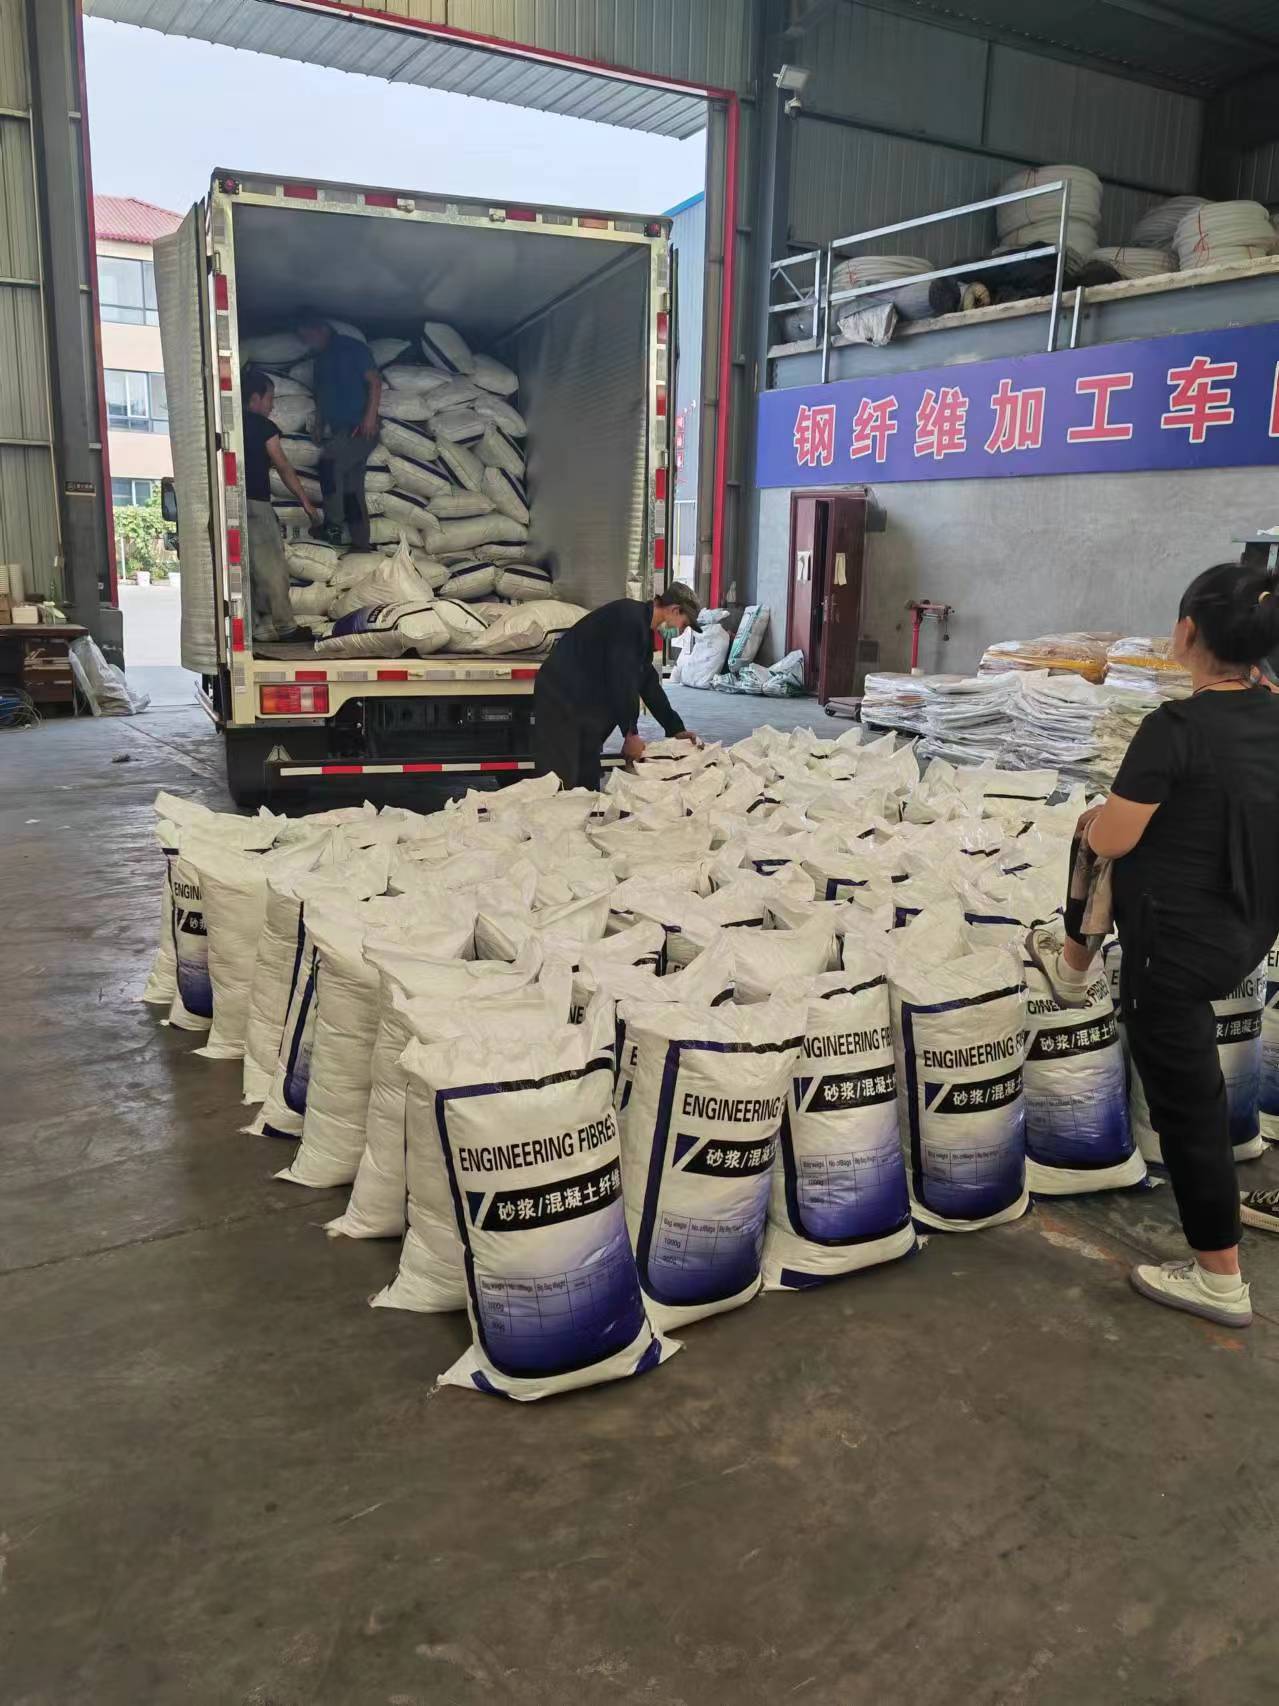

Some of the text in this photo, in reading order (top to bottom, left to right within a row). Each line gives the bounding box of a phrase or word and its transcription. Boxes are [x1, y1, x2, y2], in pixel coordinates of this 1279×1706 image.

[793, 355, 1279, 467] 钢纤维加工车
[796, 1029, 880, 1059] NGINEERING
[923, 1036, 1015, 1069] ENGINEERING
[682, 1092, 781, 1122] ENGINEERING
[459, 1112, 616, 1172] ENGINEERING FIBRES
[497, 1168, 621, 1222] 砂浆/混凝土纤维
